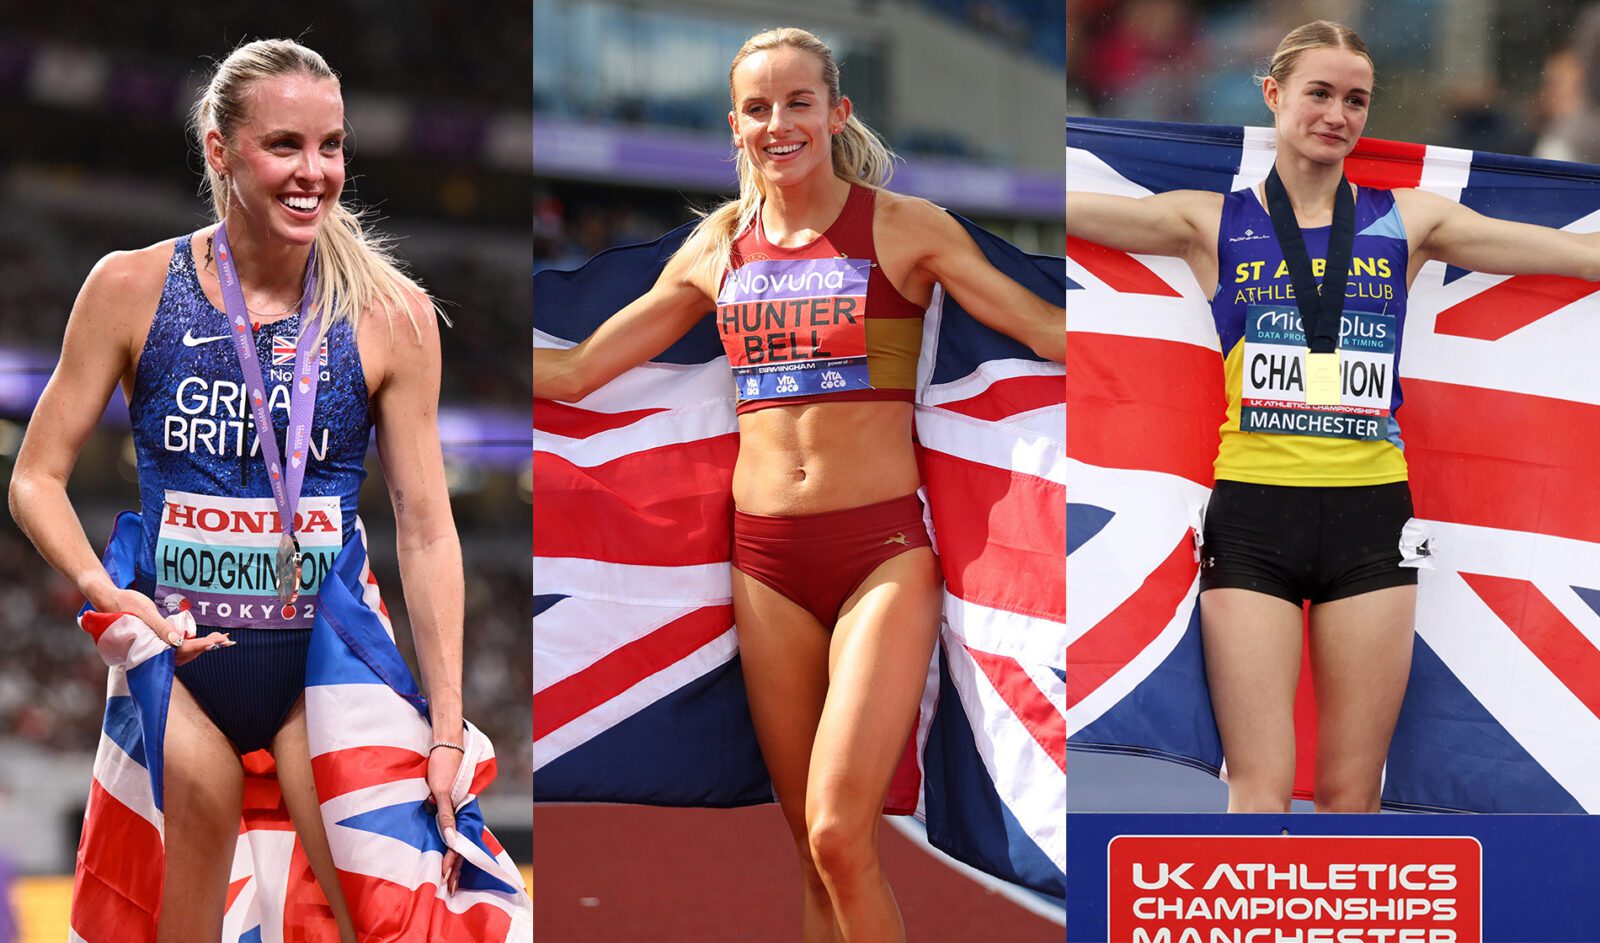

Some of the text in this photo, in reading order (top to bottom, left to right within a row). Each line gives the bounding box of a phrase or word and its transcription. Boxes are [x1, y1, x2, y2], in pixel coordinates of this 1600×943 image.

[735, 270, 844, 295] Novuna
[1234, 257, 1391, 283] ST ABNS
[1234, 282, 1393, 304] ATHLE CLUB
[722, 297, 857, 335] HUNTER
[1256, 311, 1387, 348] Micplus
[1258, 331, 1281, 339] DATA
[744, 331, 832, 364] BELL
[1352, 338, 1384, 348] TIMING
[271, 368, 330, 382] Noa
[759, 363, 816, 374] BIRMINGHAM
[777, 375, 796, 386] VITA
[821, 371, 842, 381] VITA
[1250, 353, 1386, 399] CHAION
[776, 385, 798, 393] COCO
[821, 380, 846, 389] COCO
[176, 377, 291, 418] GRA
[1264, 400, 1310, 409] ATHLETICS
[1250, 411, 1378, 437] MANCHESTER
[164, 415, 329, 461] BRITN
[164, 503, 338, 534] HONDA
[163, 544, 335, 590] HODGKINON
[1132, 862, 1458, 891] UK ATHLETICS
[1132, 896, 1458, 921] CHAMPIONSHIPS
[1132, 927, 1458, 943] MANCHESTER
